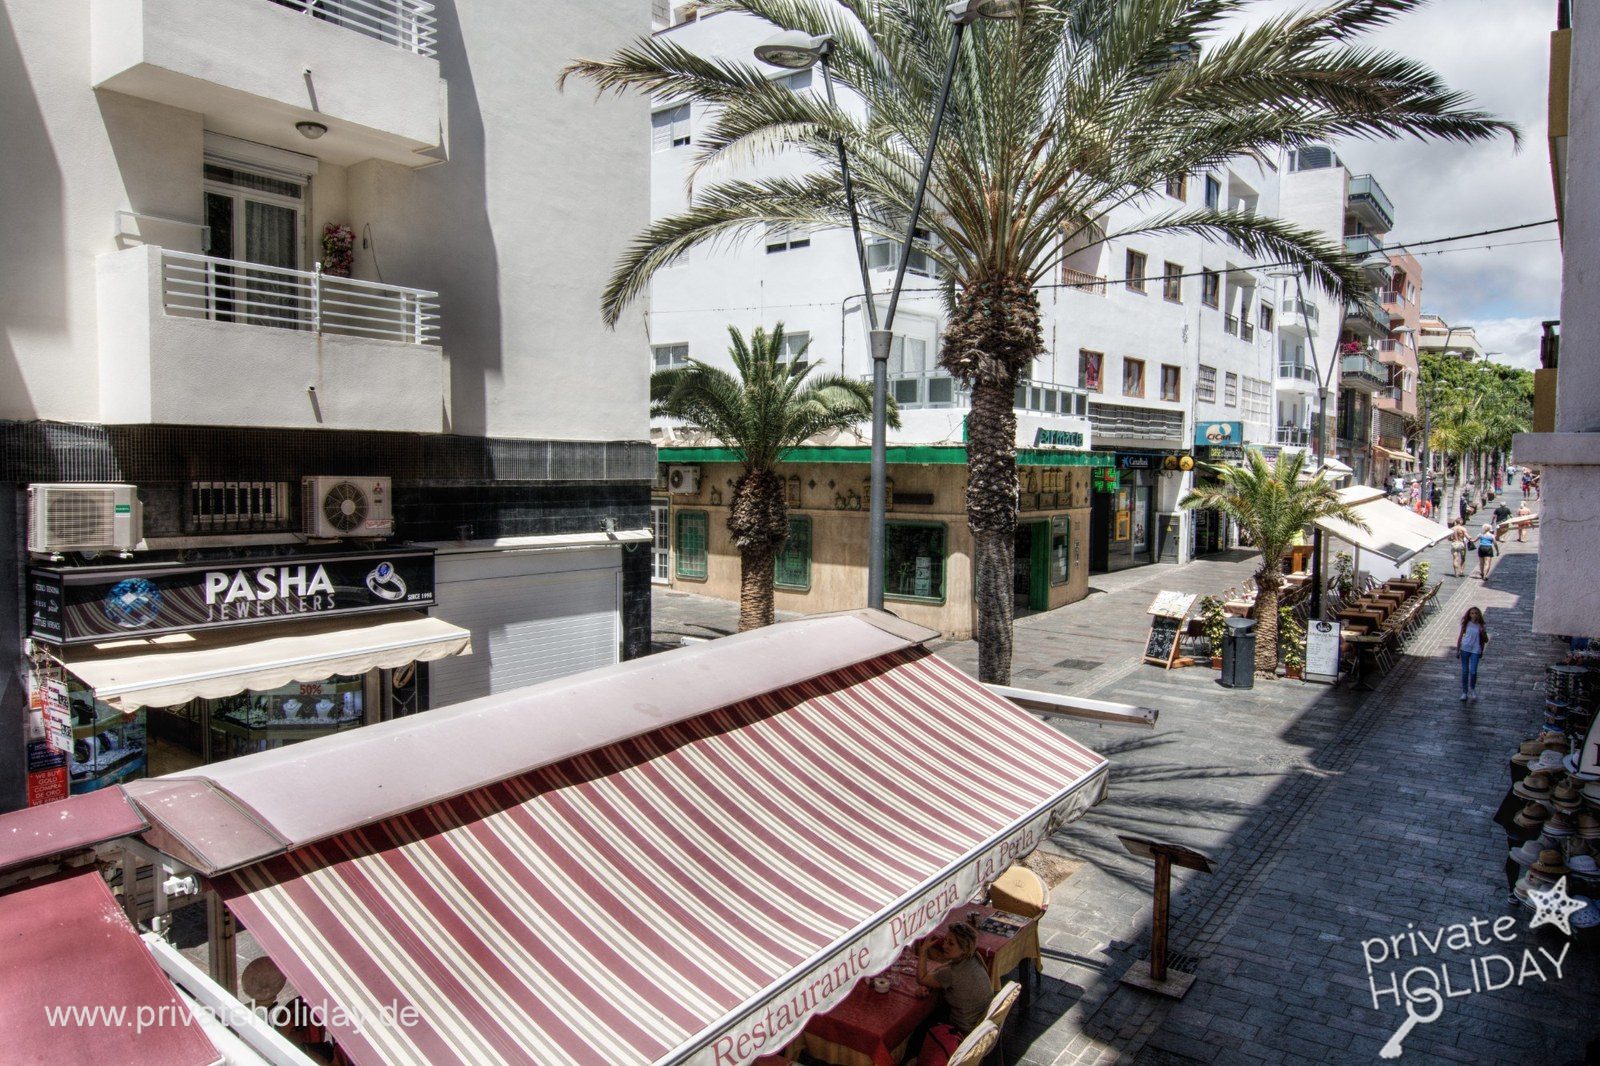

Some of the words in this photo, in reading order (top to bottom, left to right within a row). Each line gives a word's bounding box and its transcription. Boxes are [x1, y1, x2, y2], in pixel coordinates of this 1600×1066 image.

[206, 564, 336, 605] PASHA
[407, 593, 421, 601] SINCE
[206, 594, 336, 621] JEWELLERS
[300, 684, 322, 695] 50%
[711, 946, 872, 1066] Restaurante
[976, 857, 995, 885] La
[1000, 828, 1034, 867] Perla
